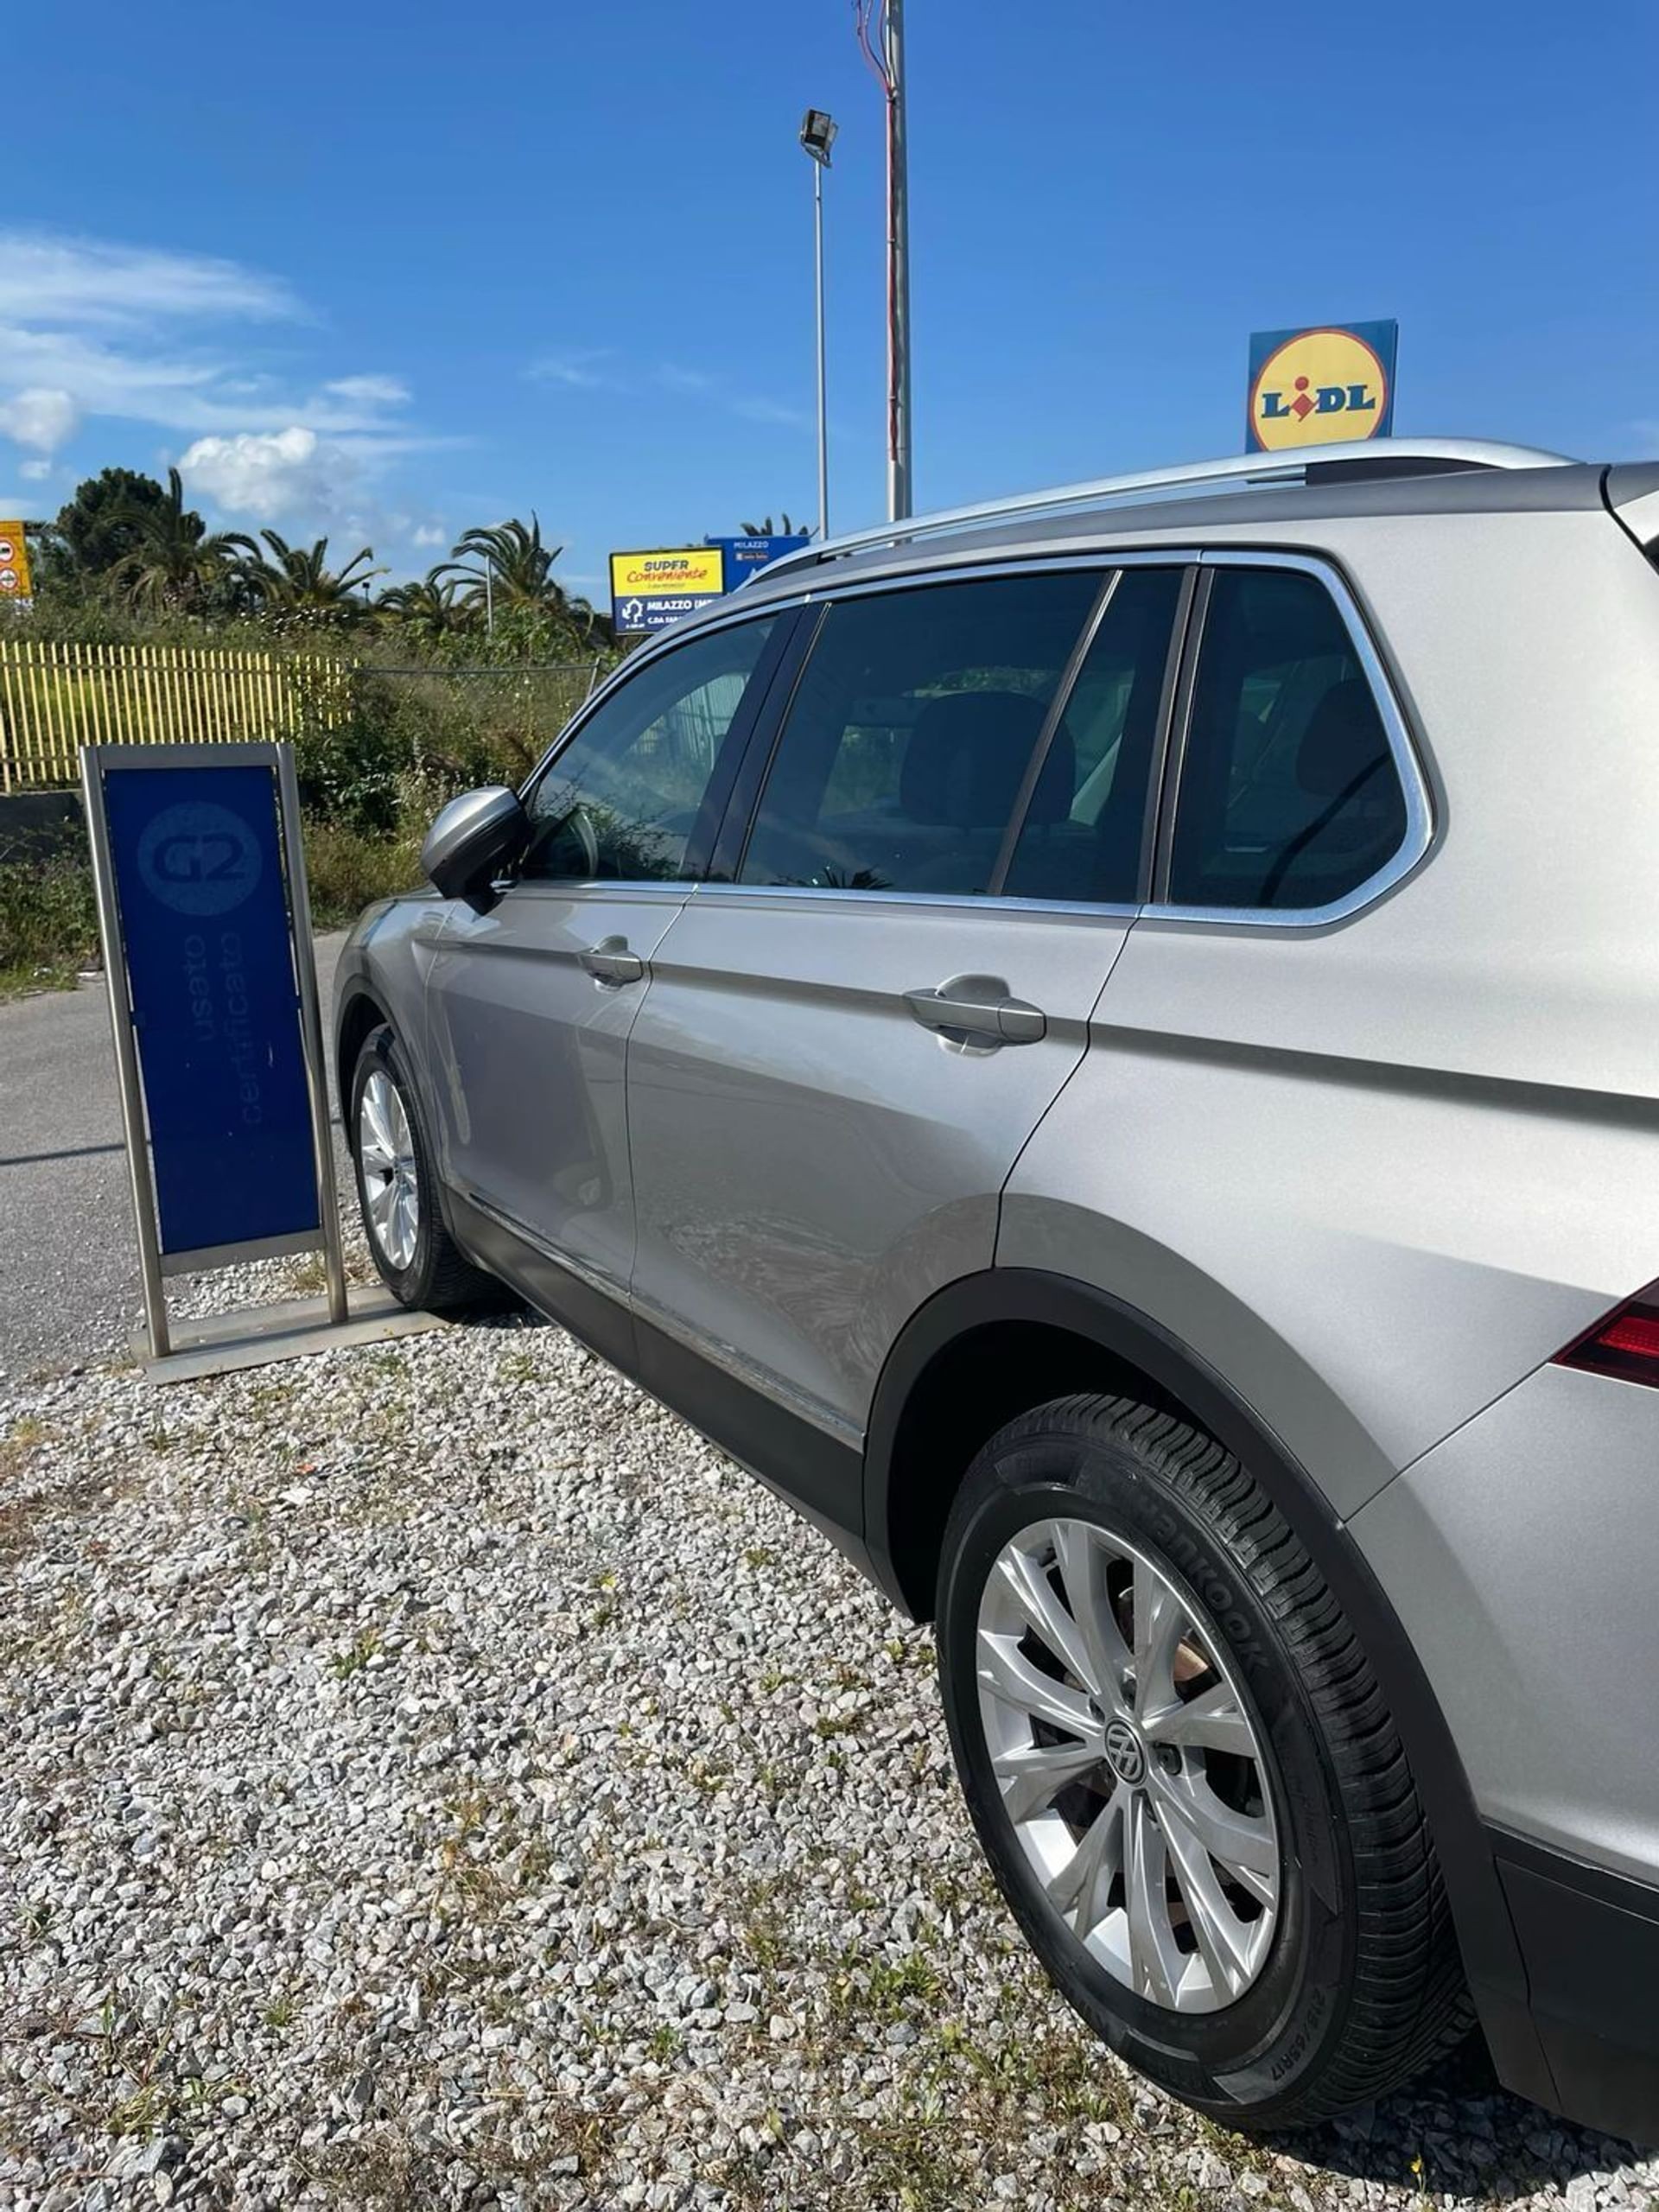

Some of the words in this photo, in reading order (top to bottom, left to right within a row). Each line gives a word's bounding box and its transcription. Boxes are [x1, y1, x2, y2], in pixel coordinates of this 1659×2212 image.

[627, 568, 707, 583] Conveniente
[644, 559, 690, 571] SUPER
[647, 600, 692, 611] MILAZZO
[152, 835, 245, 883] G2
[184, 933, 216, 1043] usato
[219, 931, 263, 1126] certificato
